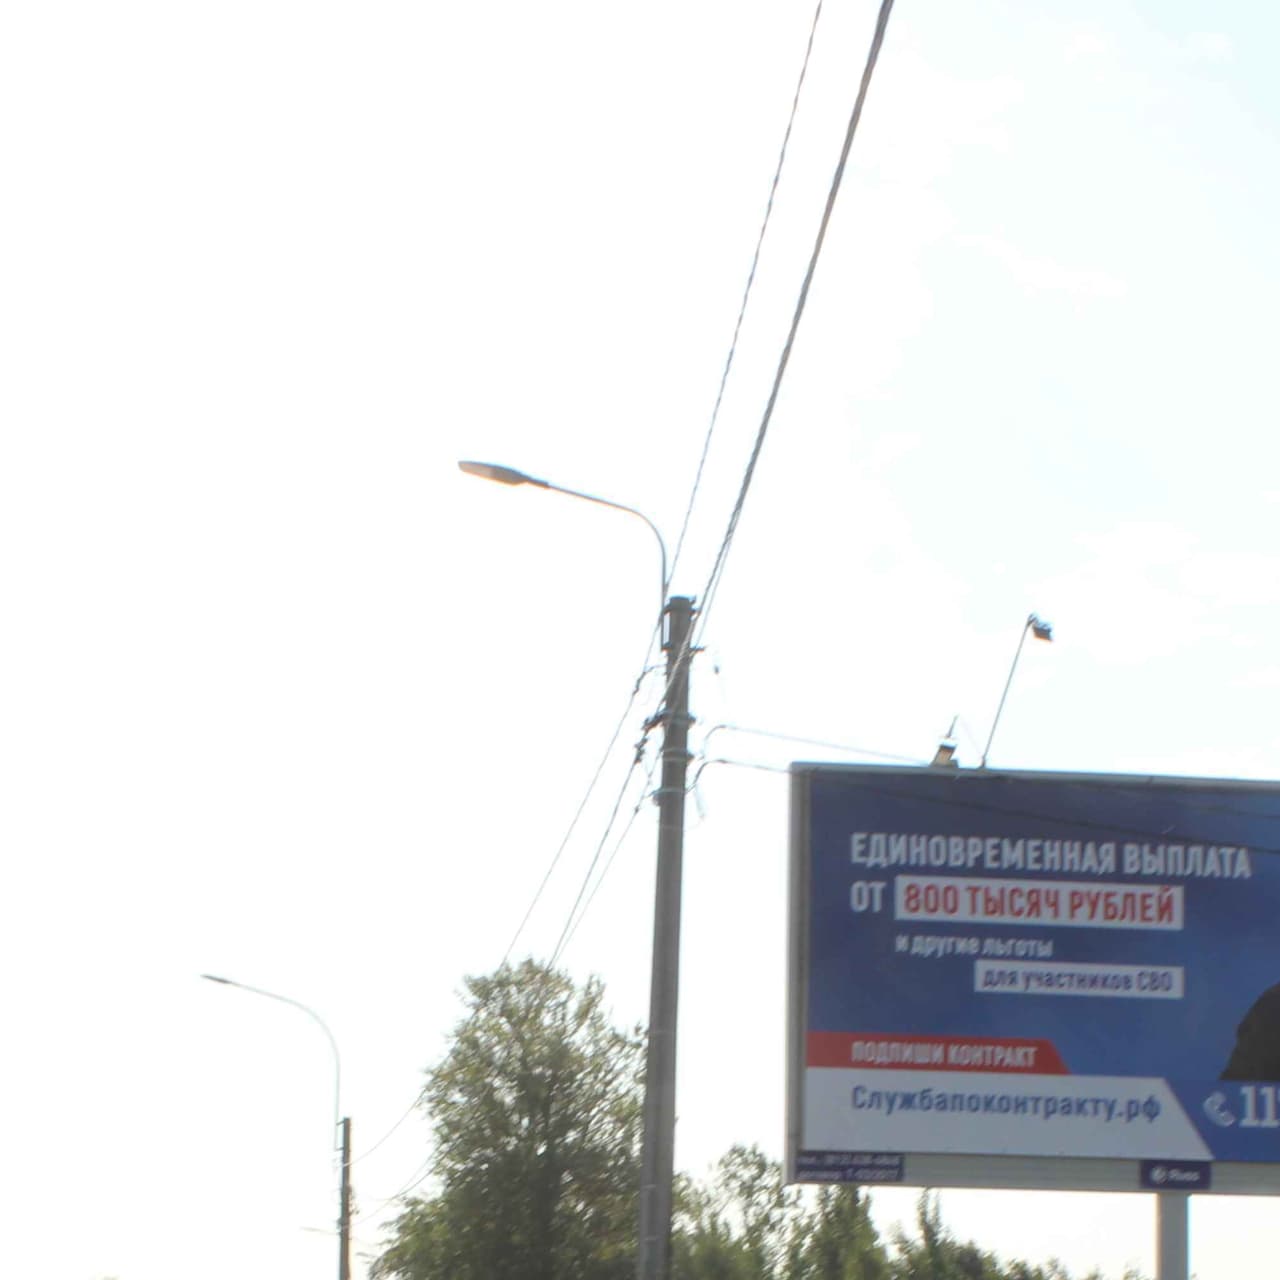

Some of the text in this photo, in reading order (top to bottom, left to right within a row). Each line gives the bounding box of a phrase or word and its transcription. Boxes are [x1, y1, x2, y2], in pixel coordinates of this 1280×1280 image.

[851, 832, 1252, 879] ЕДИНОВРЕМЕННАЯ ВЫПЛАТА
[850, 880, 1174, 924] ОТ 800 ТЫСЯЧ РУБЛЕЙ
[895, 935, 1054, 958] и другие льготы
[983, 968, 1173, 992] для участников СВО
[851, 1040, 1039, 1068] ПОДПИШИ КОНТРАКТ
[851, 1085, 1162, 1123] Службапоконтракту.рф
